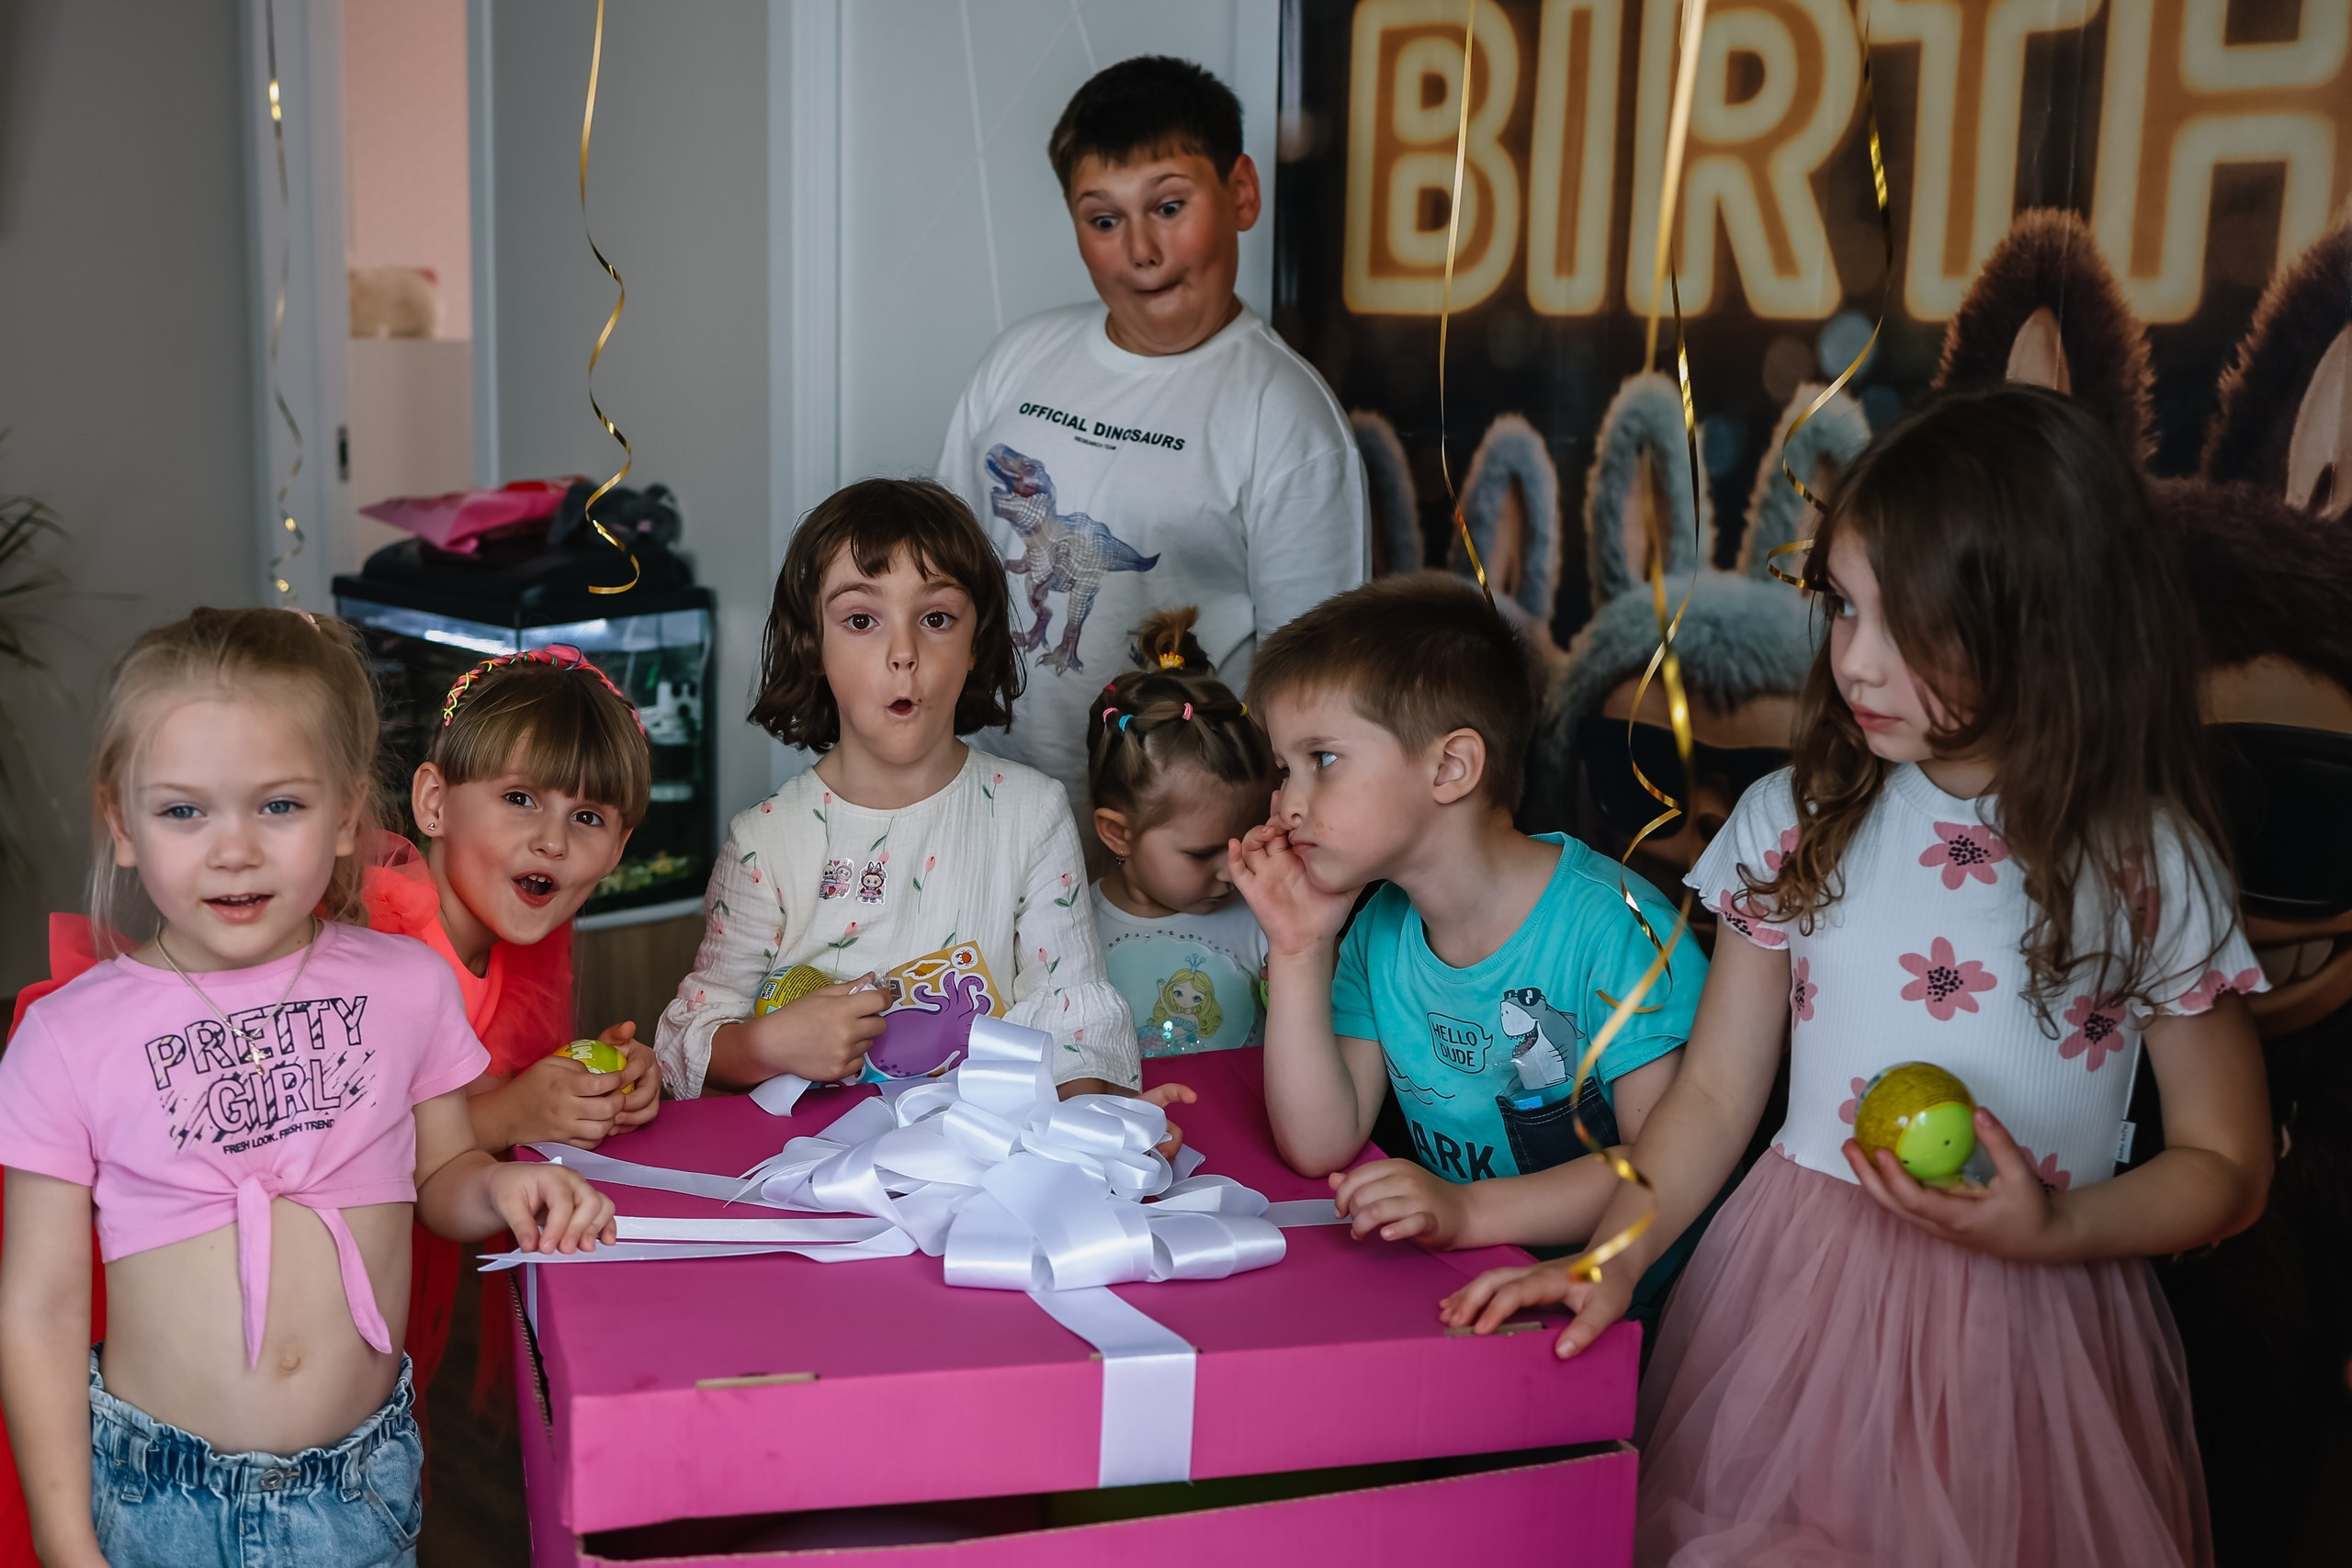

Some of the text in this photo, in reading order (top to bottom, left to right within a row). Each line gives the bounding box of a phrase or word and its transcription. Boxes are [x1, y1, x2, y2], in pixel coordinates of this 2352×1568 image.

[1342, 0, 2352, 323] BIRTH
[1019, 402, 1185, 451] OFFICIAL DINOSAURS
[144, 996, 368, 1090] PRETTY
[1431, 1021, 1477, 1046] HELLO
[1440, 1042, 1476, 1066] DUDE
[208, 1059, 341, 1134] GIRL
[223, 1140, 250, 1154] FRESH
[279, 1122, 302, 1139] FRESH
[304, 1119, 334, 1130] TREND
